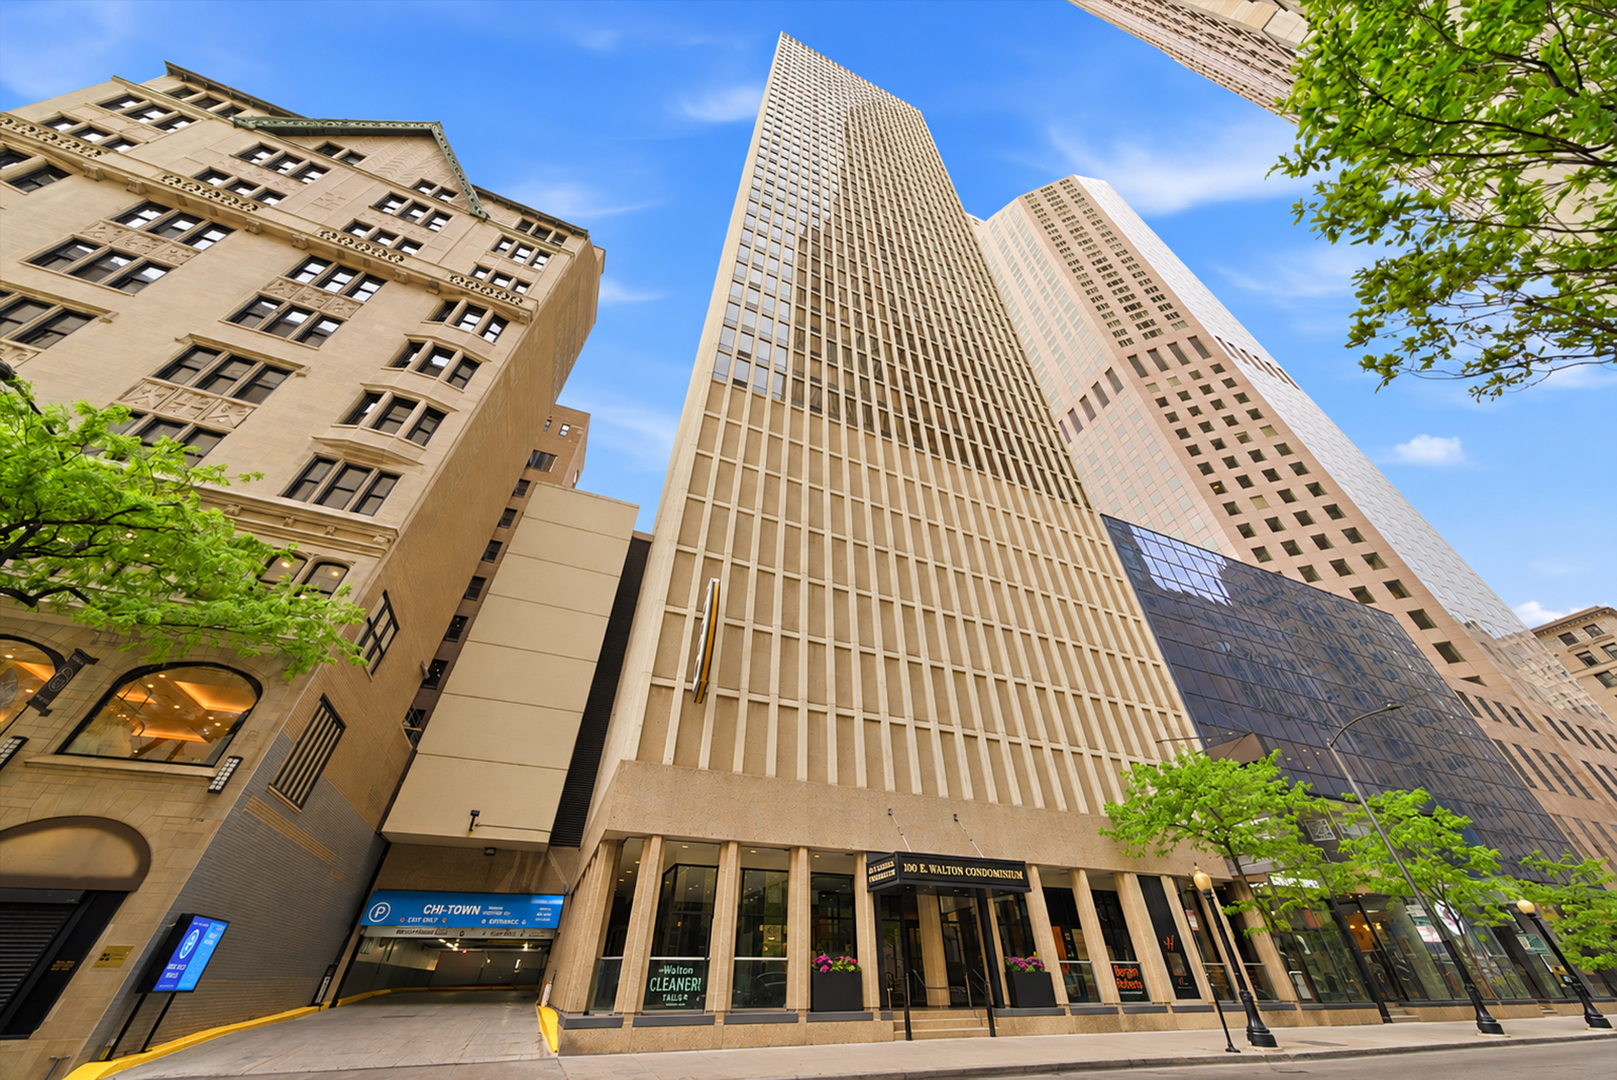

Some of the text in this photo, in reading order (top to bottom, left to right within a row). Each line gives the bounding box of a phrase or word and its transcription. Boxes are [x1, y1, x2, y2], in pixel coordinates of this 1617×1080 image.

[903, 863, 918, 873] 100
[919, 863, 929, 874] E.
[928, 864, 964, 876] WALTON
[423, 904, 481, 915] CHI-TOWN
